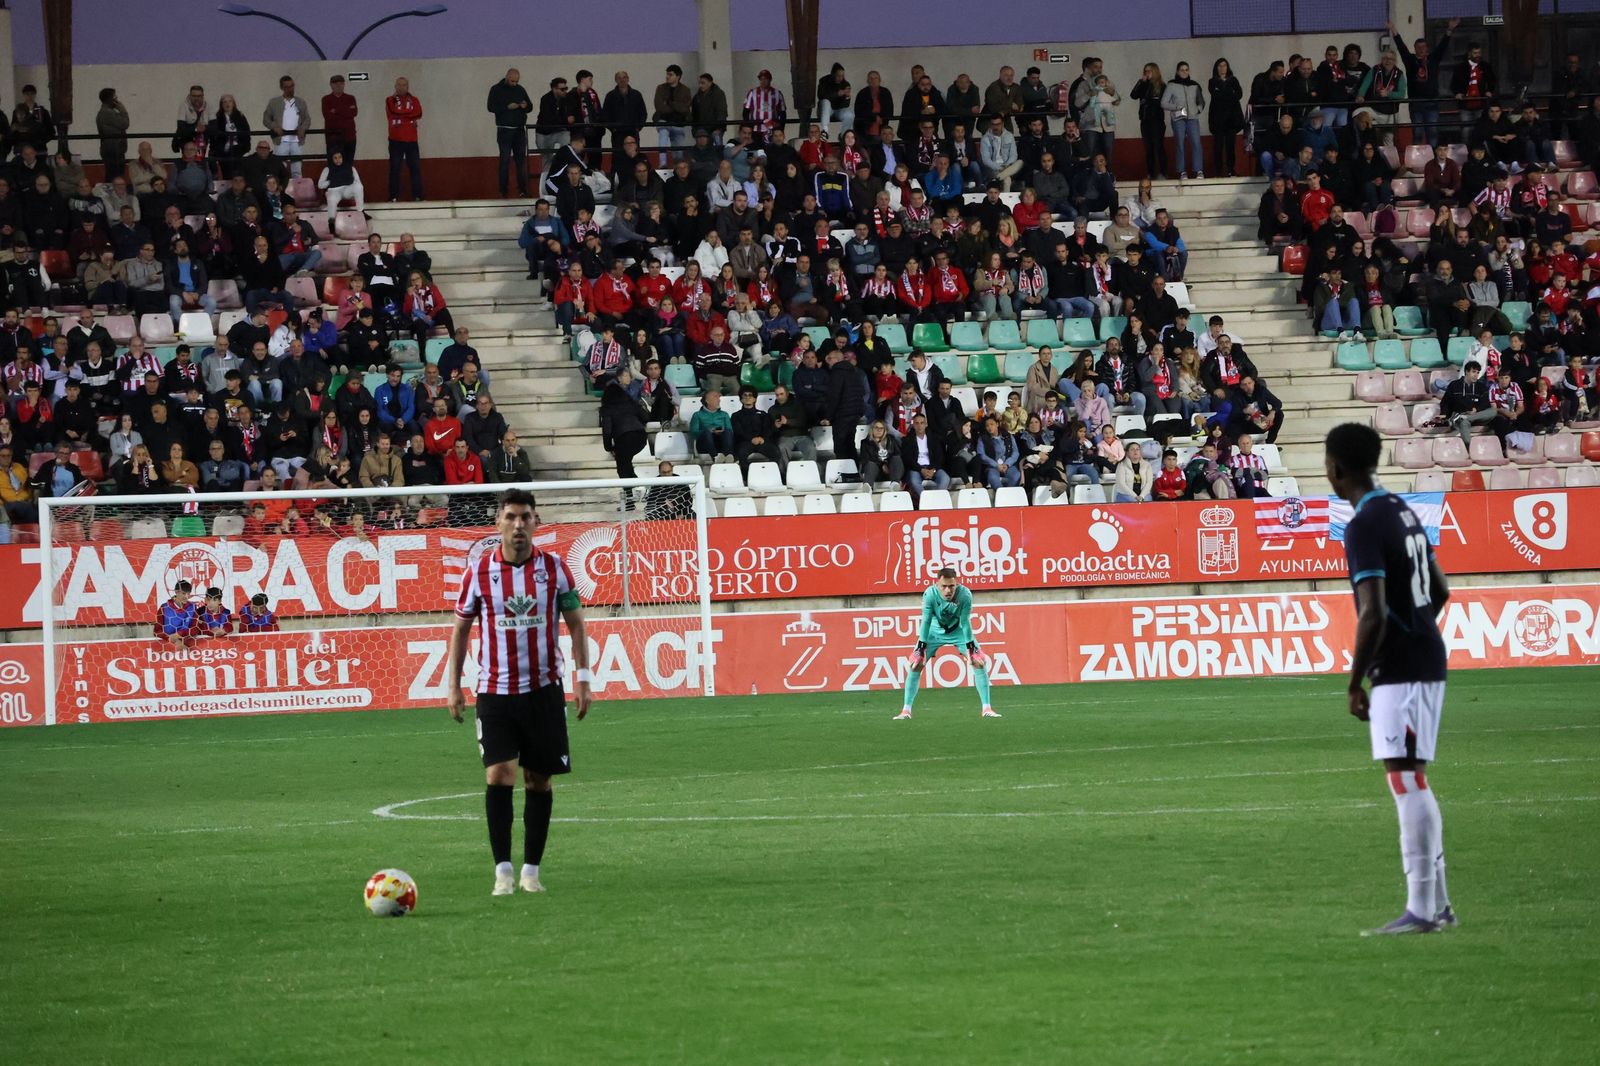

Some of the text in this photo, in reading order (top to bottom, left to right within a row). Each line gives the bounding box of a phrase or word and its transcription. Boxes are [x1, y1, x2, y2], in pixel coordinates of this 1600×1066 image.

[912, 514, 1012, 561] fisio
[1531, 500, 1556, 540] 8
[589, 538, 855, 577] CENTRO ÓPTICO
[1501, 520, 1542, 566] ZAMORA
[21, 534, 427, 622] ZAMORA CF
[650, 571, 798, 598] ROBERTO
[1041, 548, 1171, 583] podoactiva
[1060, 570, 1171, 583] PODOLOGÍA Y BIOMECÁNICA
[497, 616, 544, 628] CAJA RURAL
[146, 647, 238, 665] bodegas
[303, 638, 337, 656] del
[644, 628, 723, 691] CF
[1079, 635, 1335, 681] ZAMORANAS
[106, 647, 361, 697] Sumiller
[109, 693, 363, 715] www.bodegasdelsumiller.com
